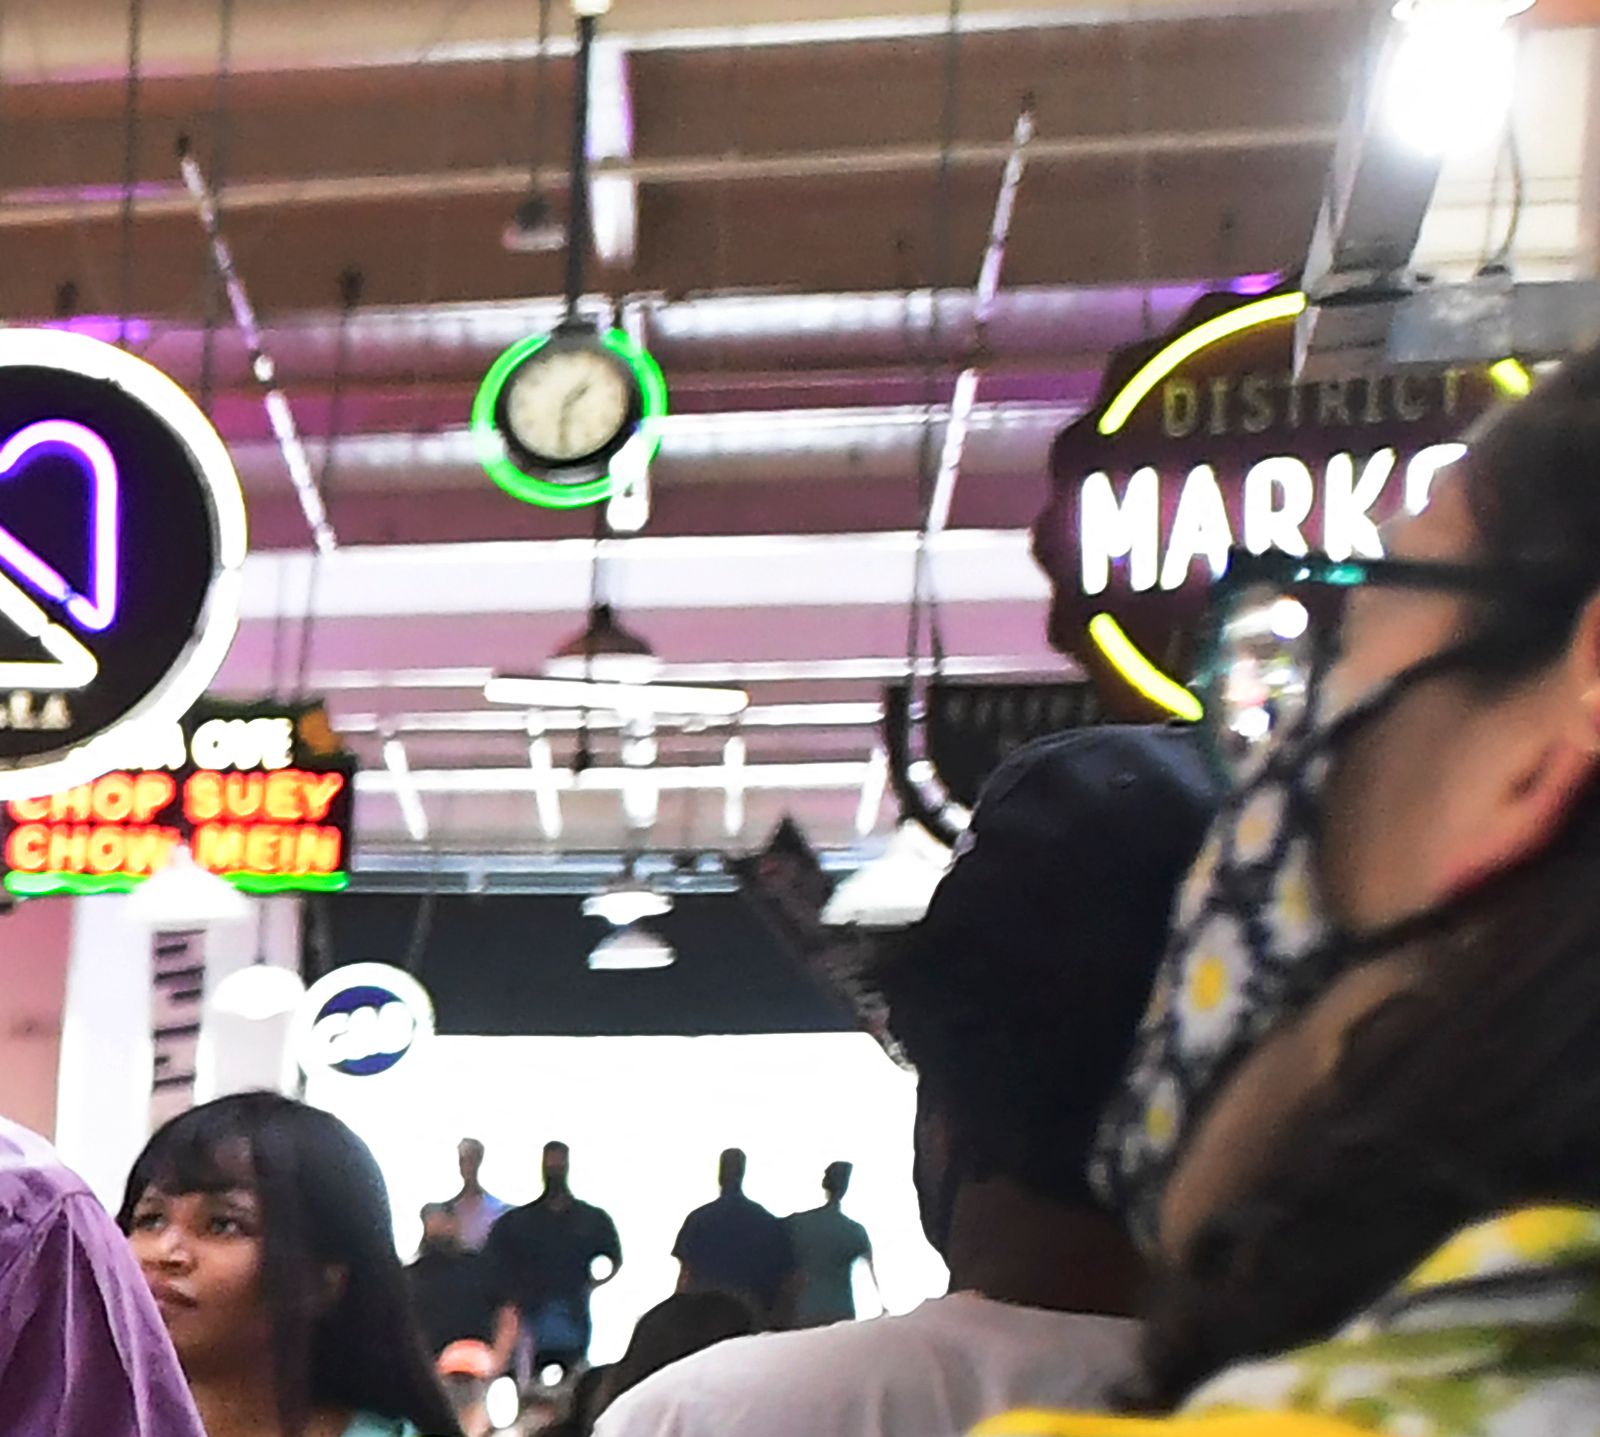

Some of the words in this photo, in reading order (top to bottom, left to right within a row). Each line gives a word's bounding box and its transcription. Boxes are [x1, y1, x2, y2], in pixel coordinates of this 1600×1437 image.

[1162, 367, 1466, 437] DISTRICT
[7, 771, 176, 824] CHOP
[183, 769, 344, 824] SUEY
[5, 823, 181, 873] CHOW
[190, 823, 342, 874] MEIN
